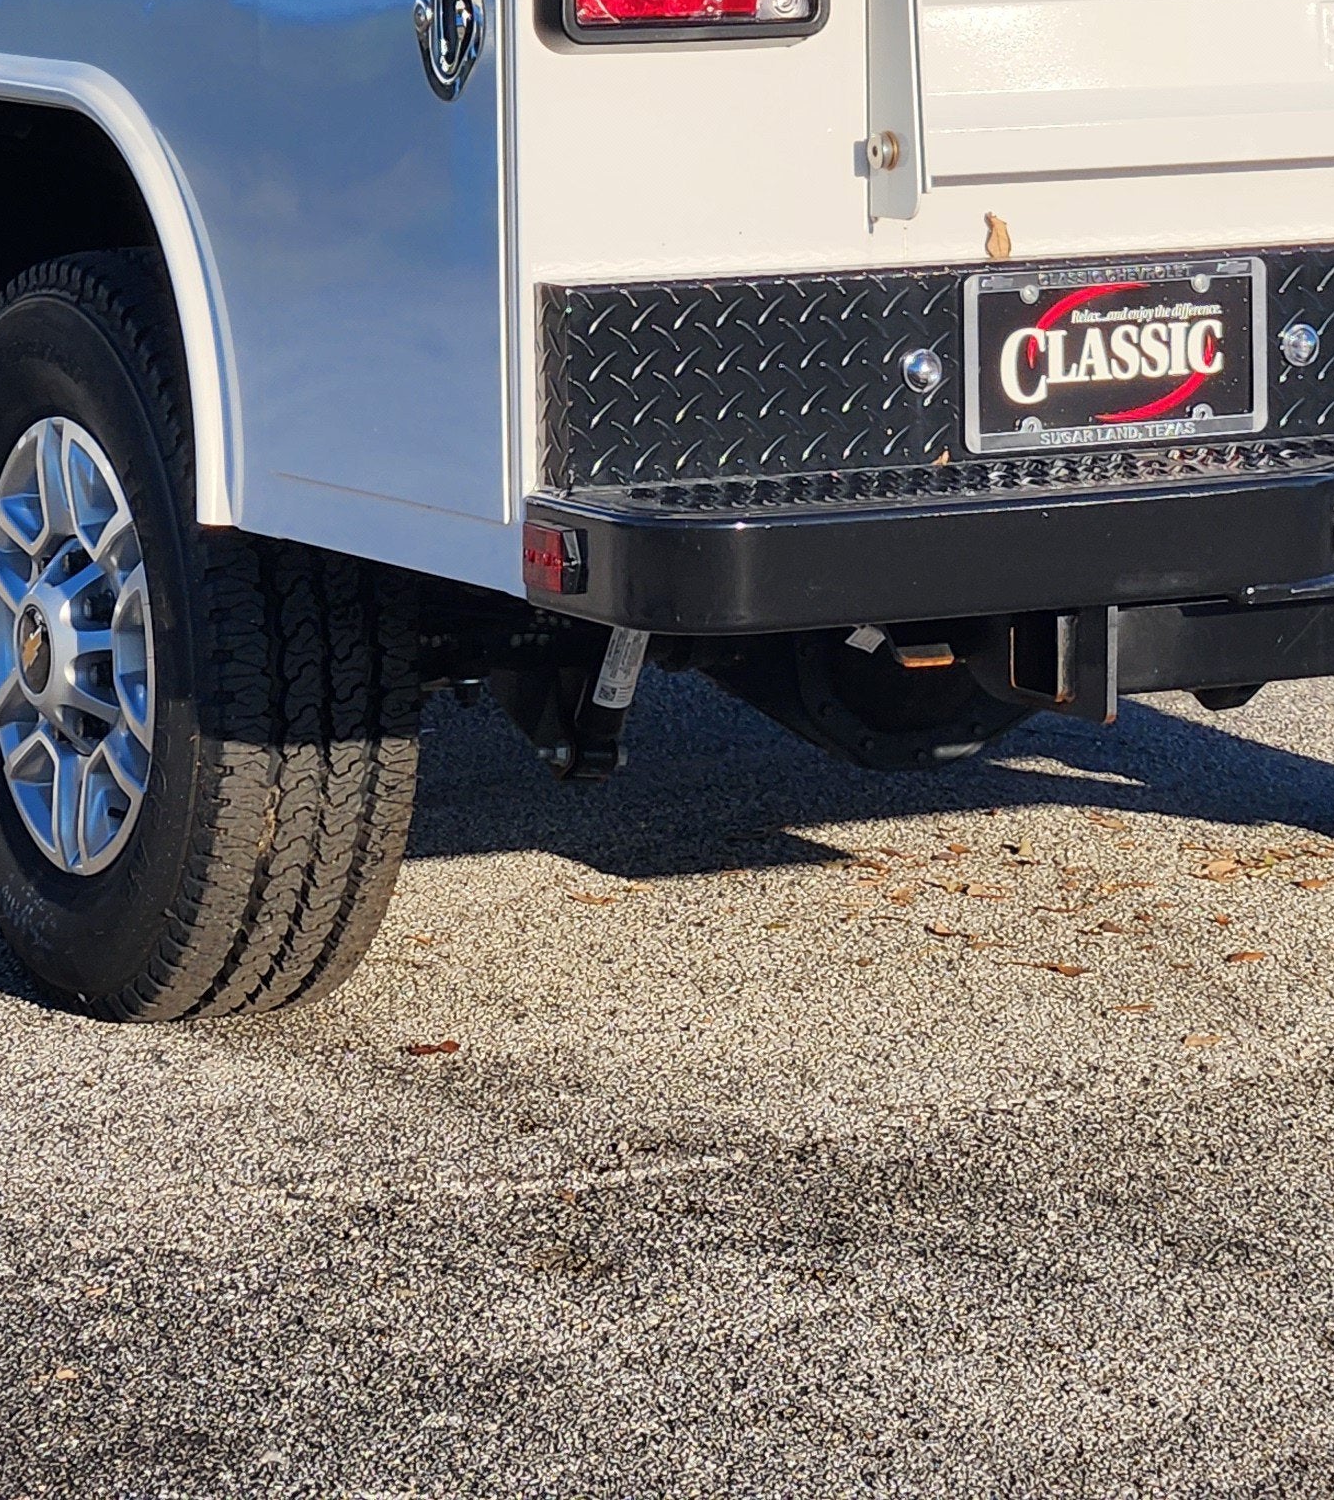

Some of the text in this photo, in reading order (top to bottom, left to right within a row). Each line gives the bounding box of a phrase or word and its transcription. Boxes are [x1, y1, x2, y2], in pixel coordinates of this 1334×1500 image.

[1038, 264, 1192, 285] CLASSIC CHEVROLET
[1128, 307, 1154, 322] enjoy
[1154, 304, 1172, 318] the
[999, 319, 1224, 405] CLASSIC
[1040, 421, 1196, 445] SUGAR LAND, TEXAS
